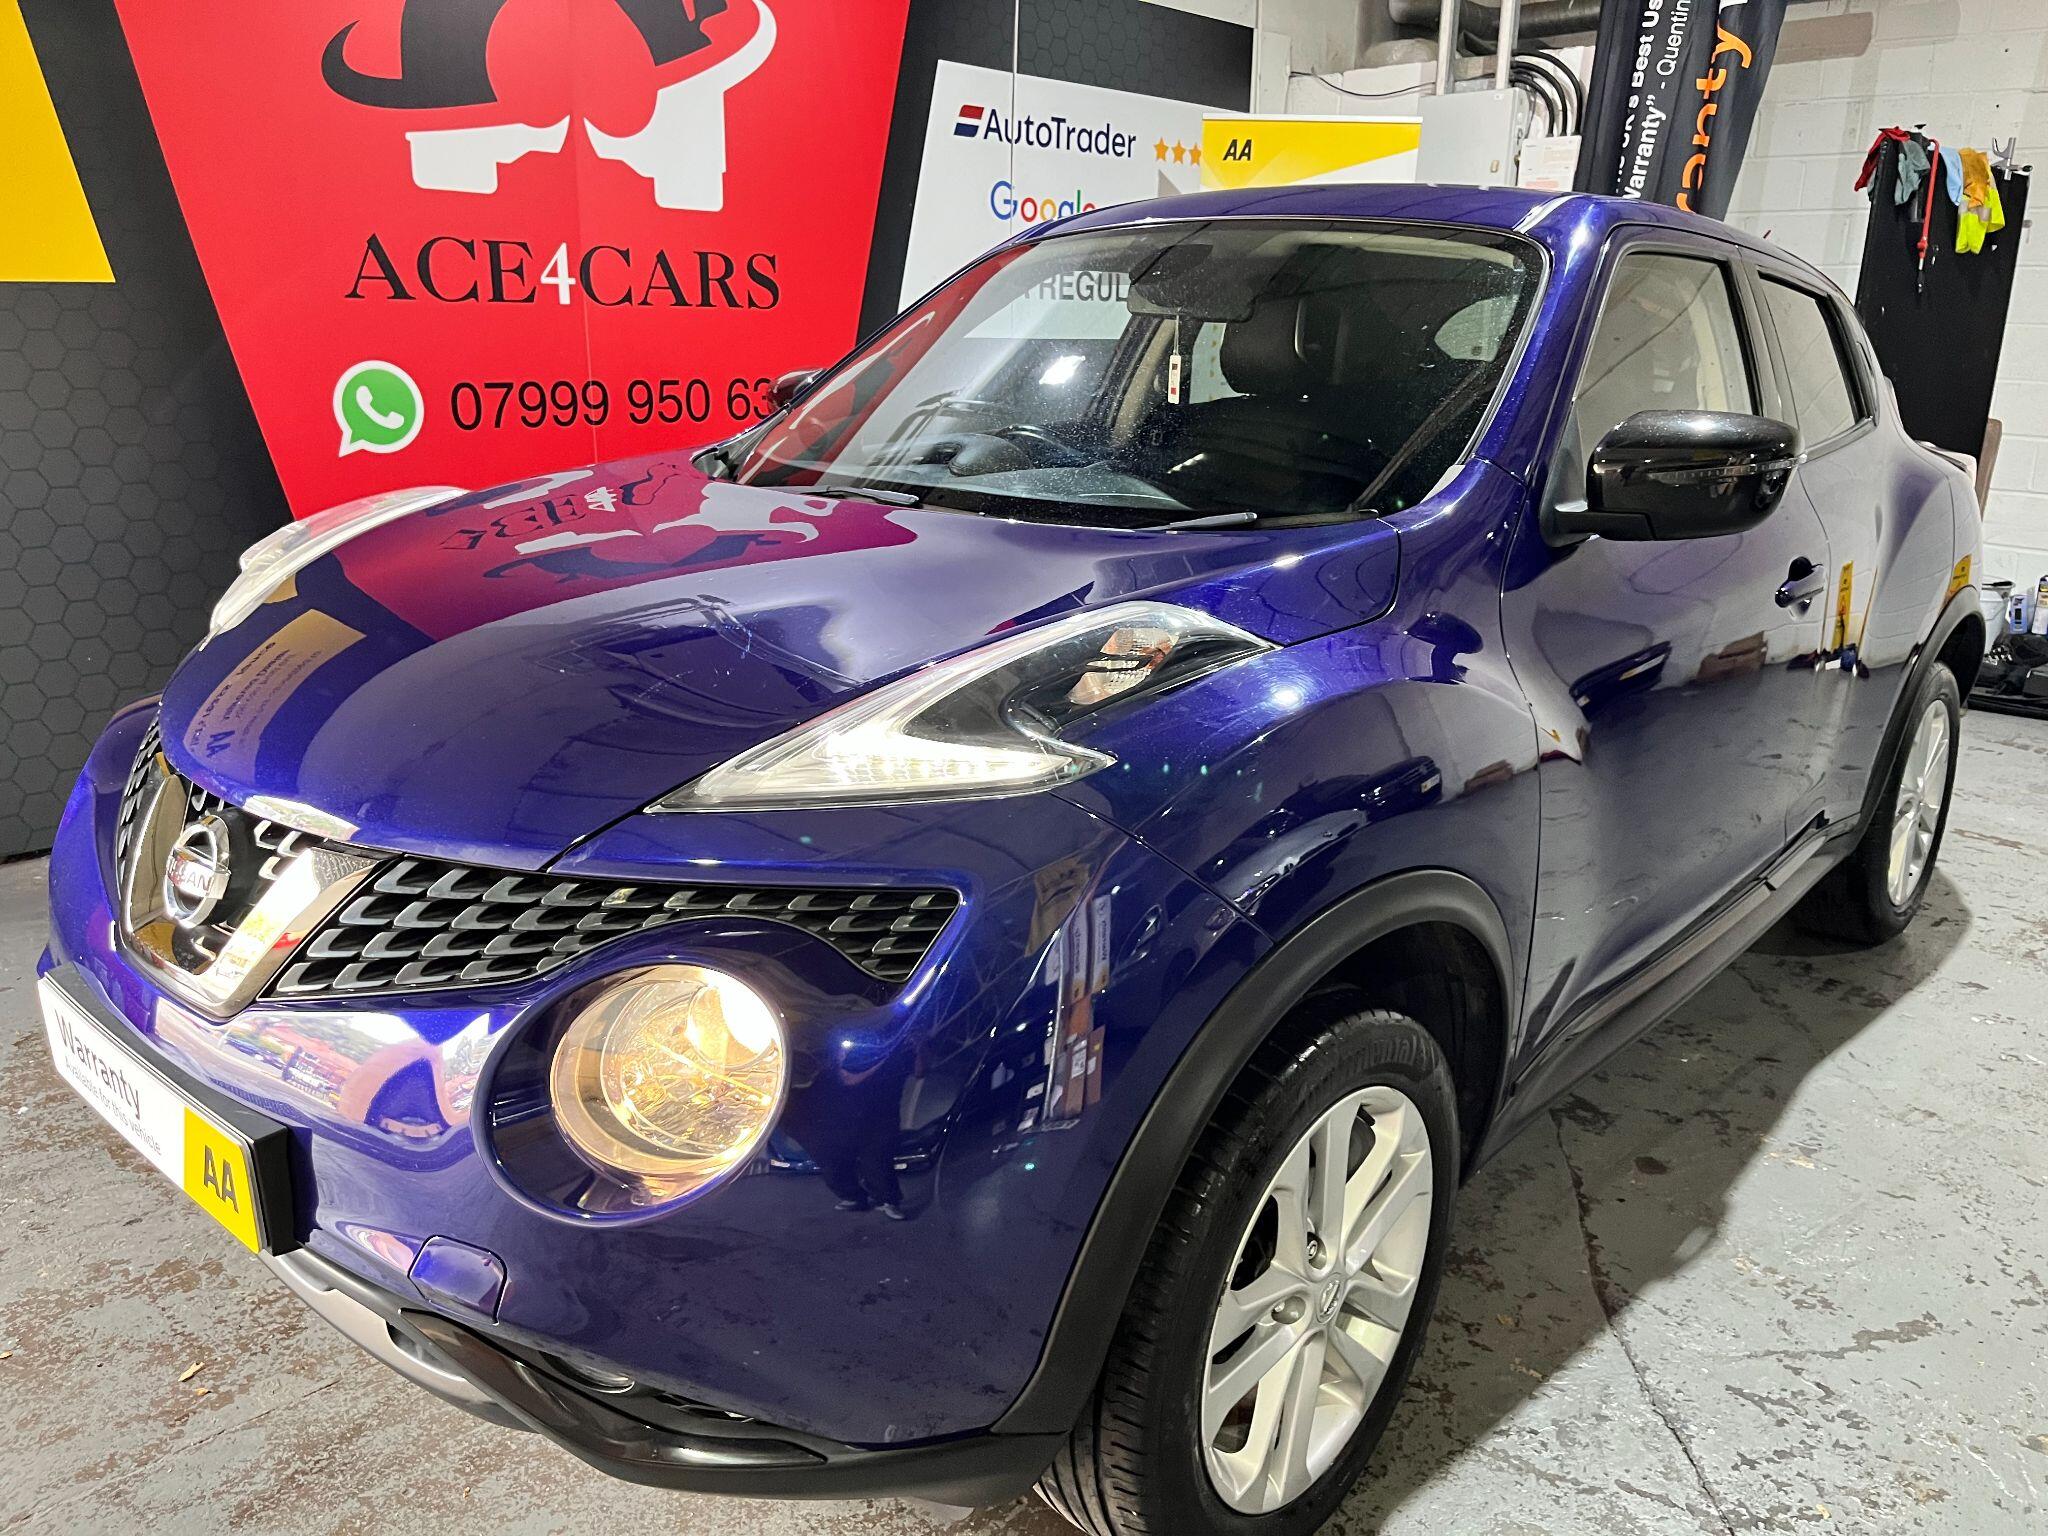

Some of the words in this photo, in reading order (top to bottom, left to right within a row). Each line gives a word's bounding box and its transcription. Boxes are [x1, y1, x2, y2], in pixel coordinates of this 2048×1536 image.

[983, 108, 1137, 158] AutoTrader
[1222, 139, 1252, 161] AA
[345, 233, 781, 310] ACE4CARS
[451, 380, 609, 431] 07999
[628, 378, 711, 424] 950
[54, 1008, 141, 1121] Warranty
[202, 1144, 240, 1214] AA
